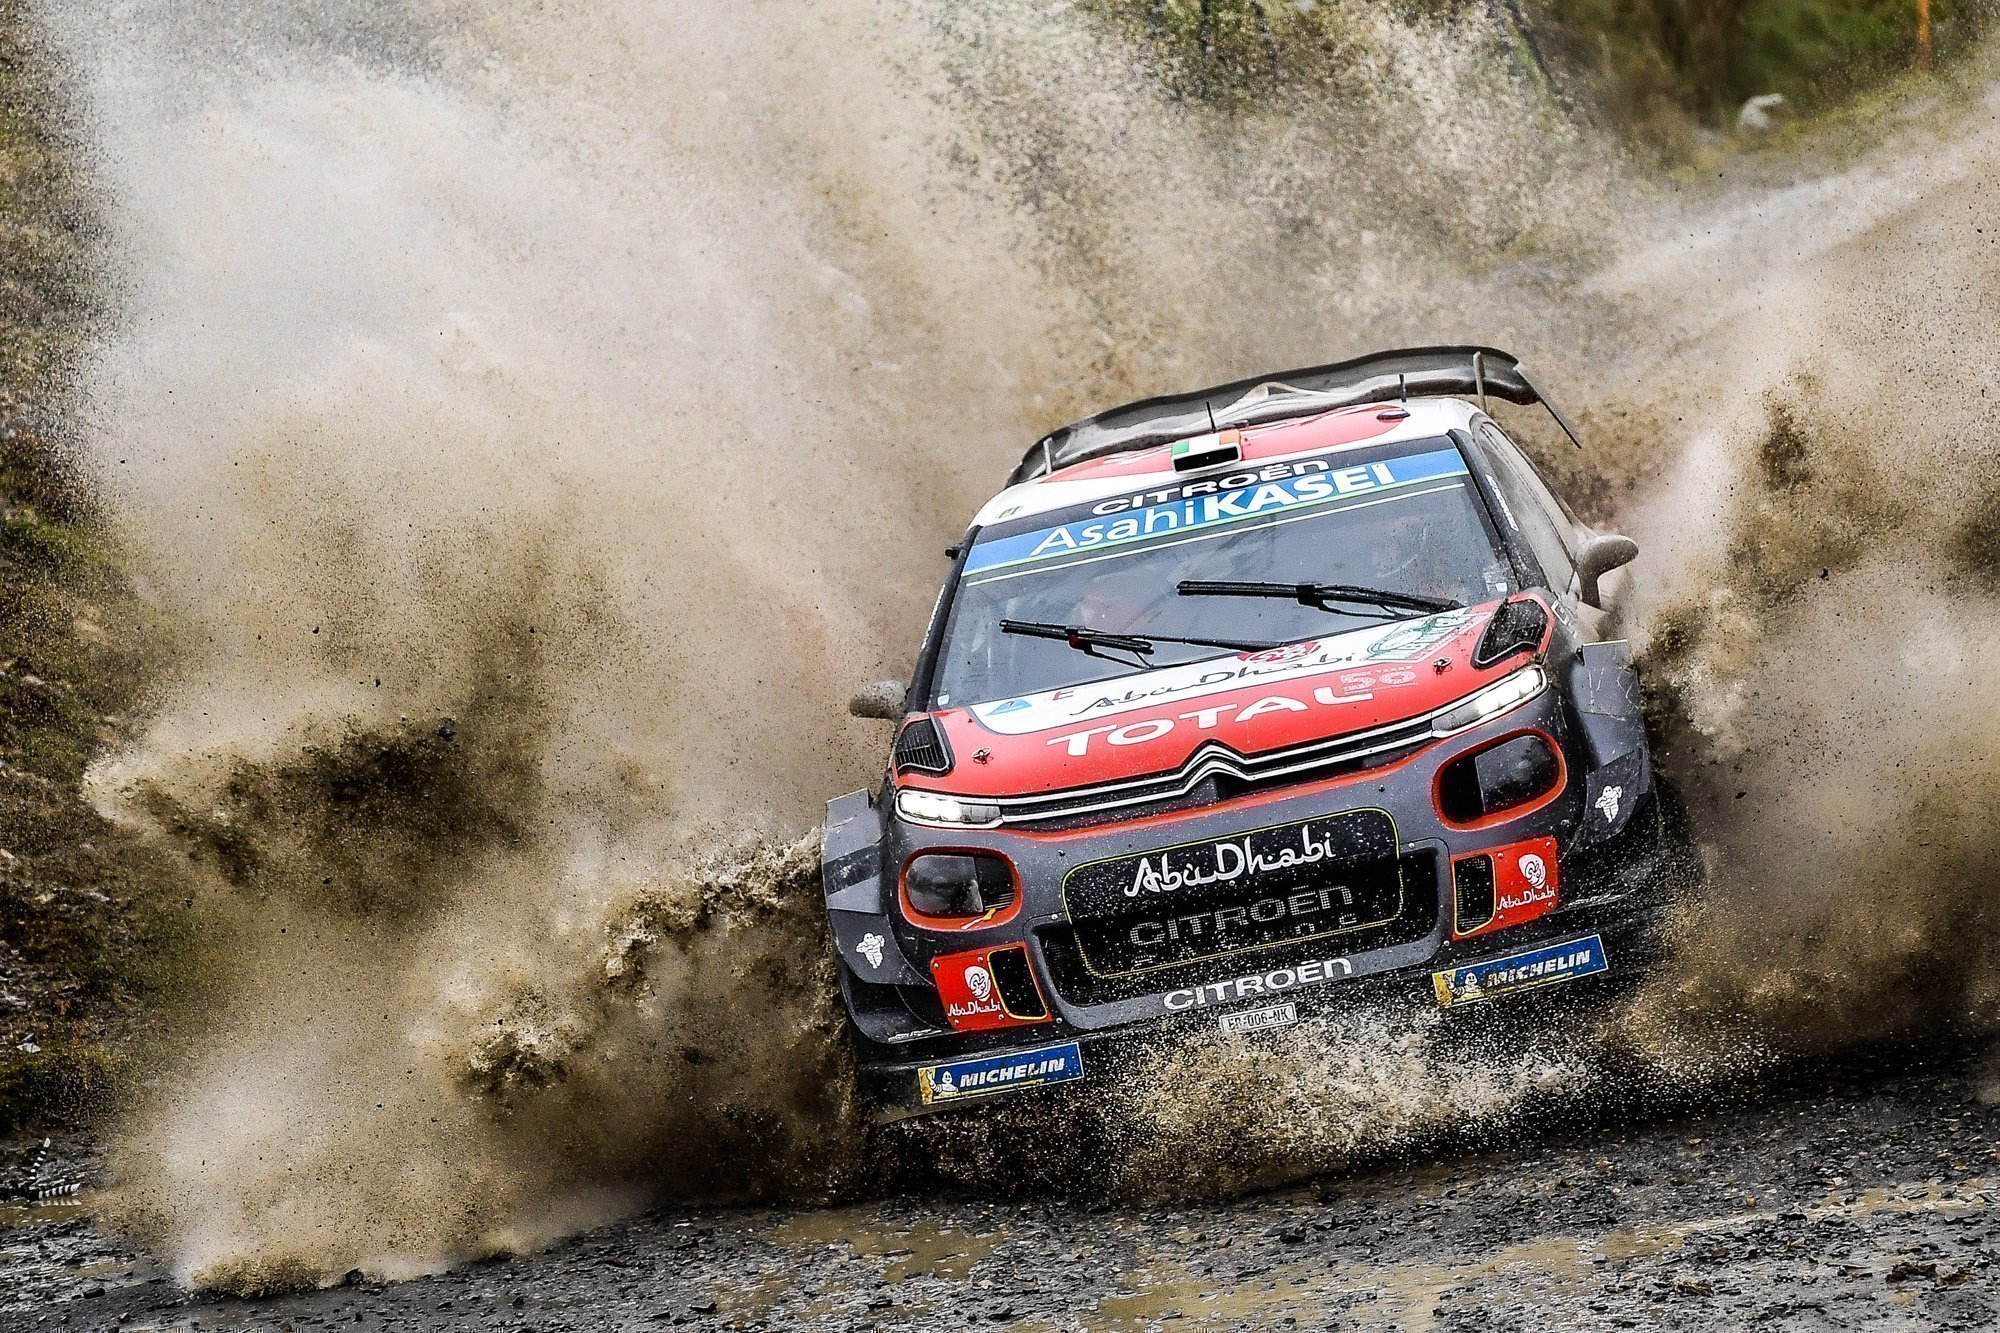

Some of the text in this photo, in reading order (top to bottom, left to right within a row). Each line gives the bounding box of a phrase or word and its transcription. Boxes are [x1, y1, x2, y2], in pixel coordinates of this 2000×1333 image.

[1091, 460, 1330, 517] CITROËN
[1046, 686, 1374, 757] TOTAL
[1129, 885, 1353, 946] CITROËN
[1163, 958, 1353, 1011] CITROËN
[1487, 950, 1590, 988] MICHELIN
[960, 1057, 1065, 1087] MICHELIN
